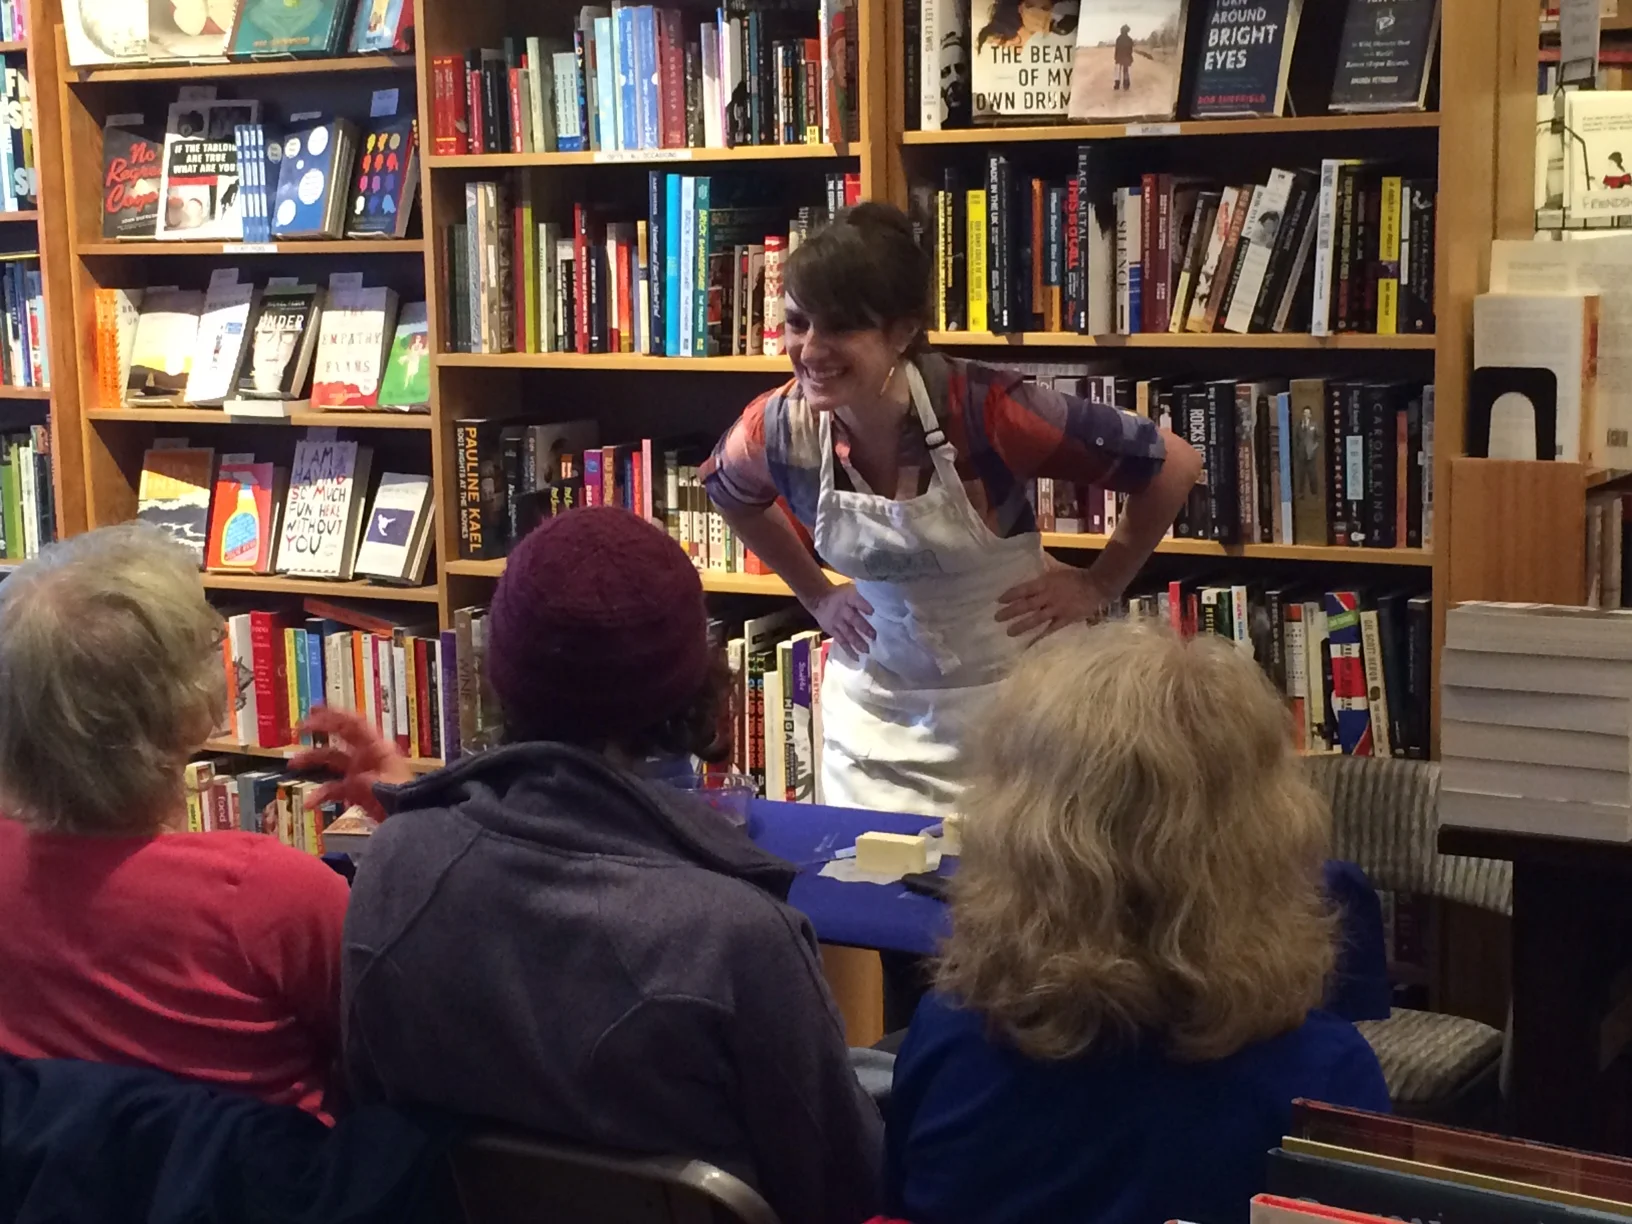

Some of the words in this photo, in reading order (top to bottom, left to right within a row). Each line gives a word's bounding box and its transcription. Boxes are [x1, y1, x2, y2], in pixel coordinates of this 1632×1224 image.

[1211, 6, 1267, 25] AROUND
[1208, 24, 1278, 47] BRIGHT
[991, 45, 1023, 64] THE
[1030, 45, 1073, 63] BEAT
[1204, 51, 1247, 71] EYES
[1018, 68, 1039, 87] OF
[1047, 68, 1073, 86] MY
[976, 91, 1015, 111] OWN
[1024, 91, 1071, 110] DRUM
[130, 142, 156, 164] No
[174, 144, 183, 154] IF
[185, 144, 201, 153] THE
[186, 154, 203, 163] ARE
[205, 153, 226, 162] TRUE
[173, 165, 197, 174] WHAT
[199, 164, 215, 173] ARE
[218, 164, 236, 173] YOU
[990, 158, 998, 183] MADE
[1078, 154, 1087, 193] BLACK
[990, 184, 998, 193] IN
[990, 194, 998, 211] THE
[698, 210, 706, 236] BRICK
[990, 212, 998, 225] UK
[1078, 200, 1087, 242] METAL
[1117, 220, 1127, 292] SILENCE
[321, 332, 382, 346] EMPATHY
[1190, 409, 1205, 442] ROCKS
[1373, 403, 1383, 470] CAROLE
[300, 447, 305, 466] I
[310, 447, 334, 468] AM
[458, 449, 466, 478] NIGHTS
[465, 427, 480, 502] PAULINE
[294, 467, 347, 487] HAVING
[459, 479, 466, 489] AT
[313, 485, 346, 503] MUCH
[1373, 481, 1383, 523] KING
[289, 503, 312, 518] FUN
[319, 503, 340, 518] HERE
[287, 518, 343, 536] WITHOUT
[468, 508, 482, 553] KAEL
[285, 534, 322, 555] YOU
[784, 697, 793, 741] MEGA
[218, 795, 227, 822] food
